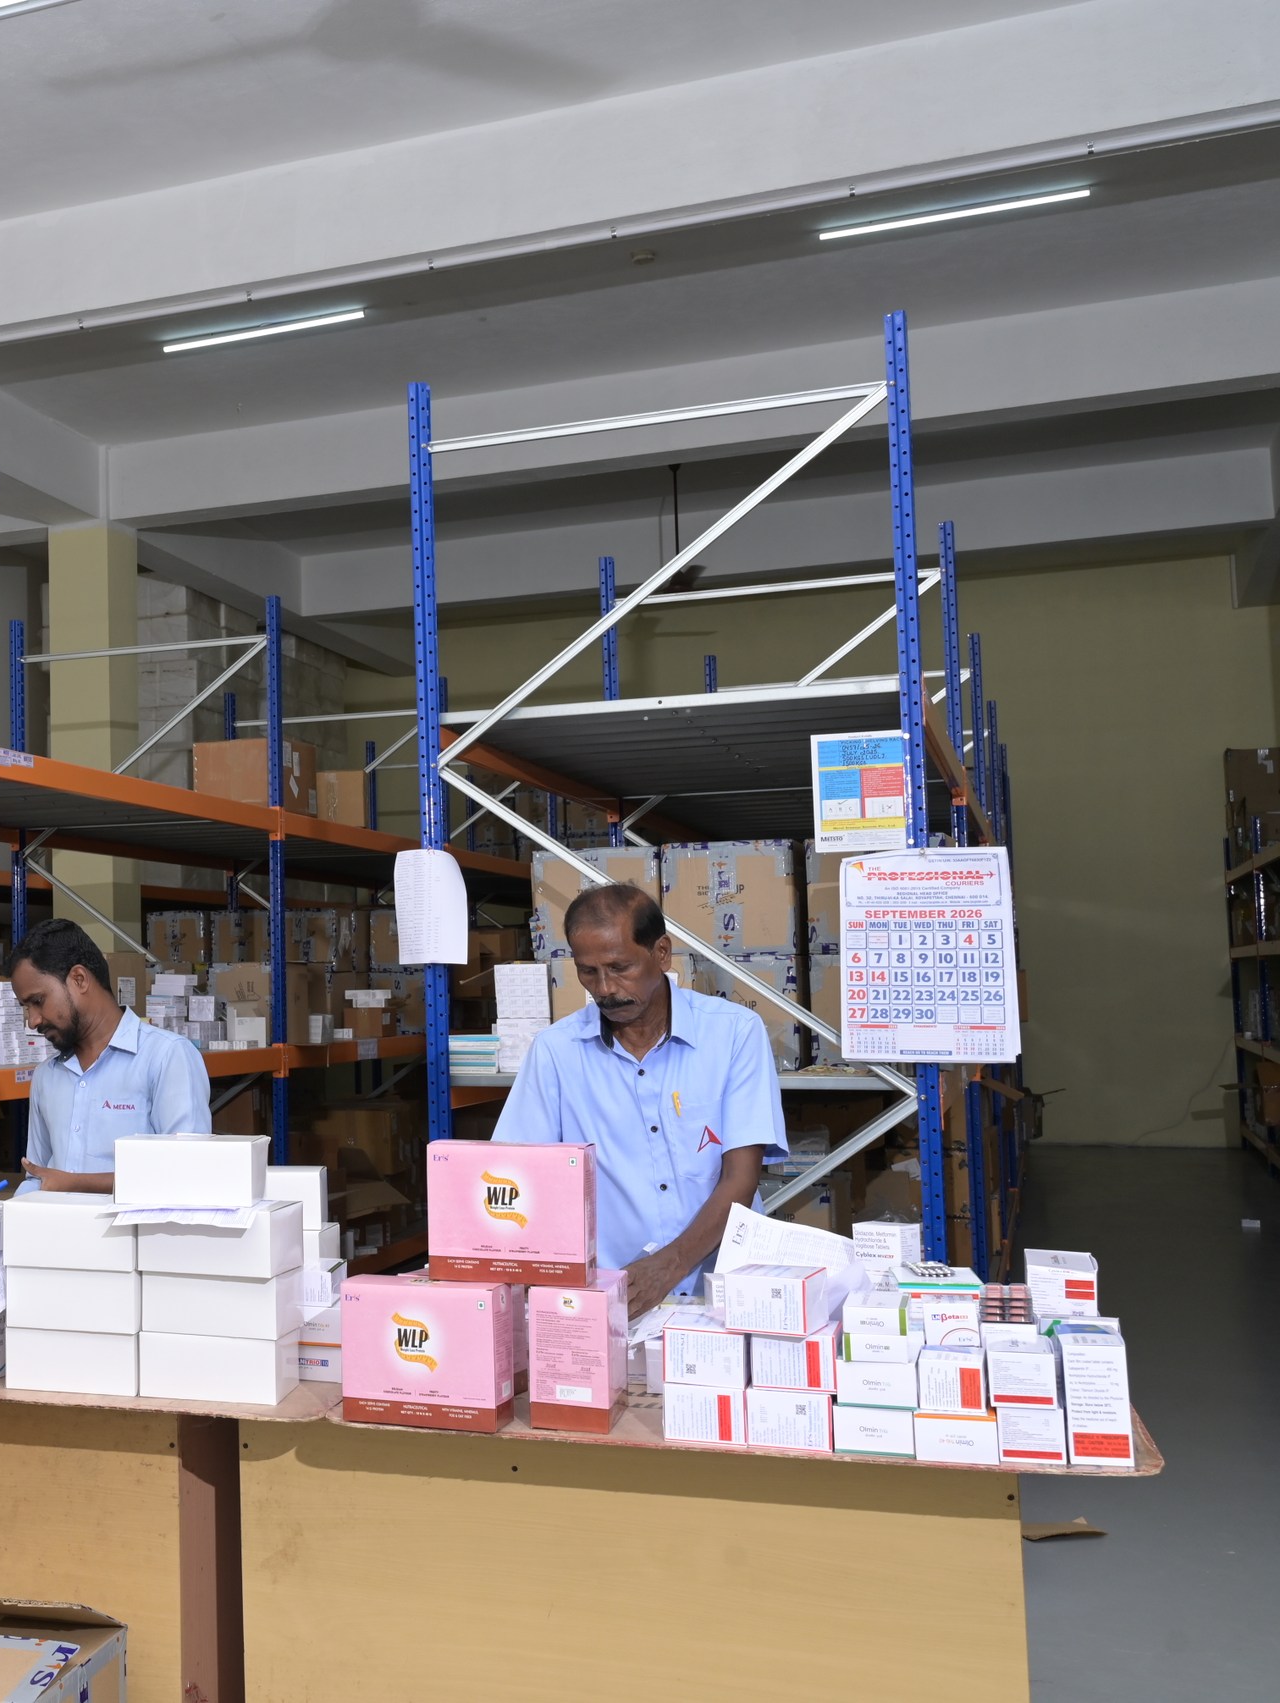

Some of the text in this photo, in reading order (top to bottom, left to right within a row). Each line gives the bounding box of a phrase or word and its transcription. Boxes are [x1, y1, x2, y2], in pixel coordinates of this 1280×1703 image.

[867, 871, 984, 880] PROFESSIONAL
[865, 910, 982, 918] SEPTEMBER 2026
[898, 934, 996, 945] 1 2 3 4 5
[852, 953, 999, 963] 6 7 8 9 10 11 12
[849, 971, 1000, 982] 13 14 15 16 17 18 19
[848, 989, 1002, 1001] 20 21 22 23 24 25 26
[849, 1008, 934, 1019] 27 28 29 30
[487, 1186, 519, 1206] WLP
[732, 1222, 746, 1246] Eris
[398, 1328, 428, 1348] WLP
